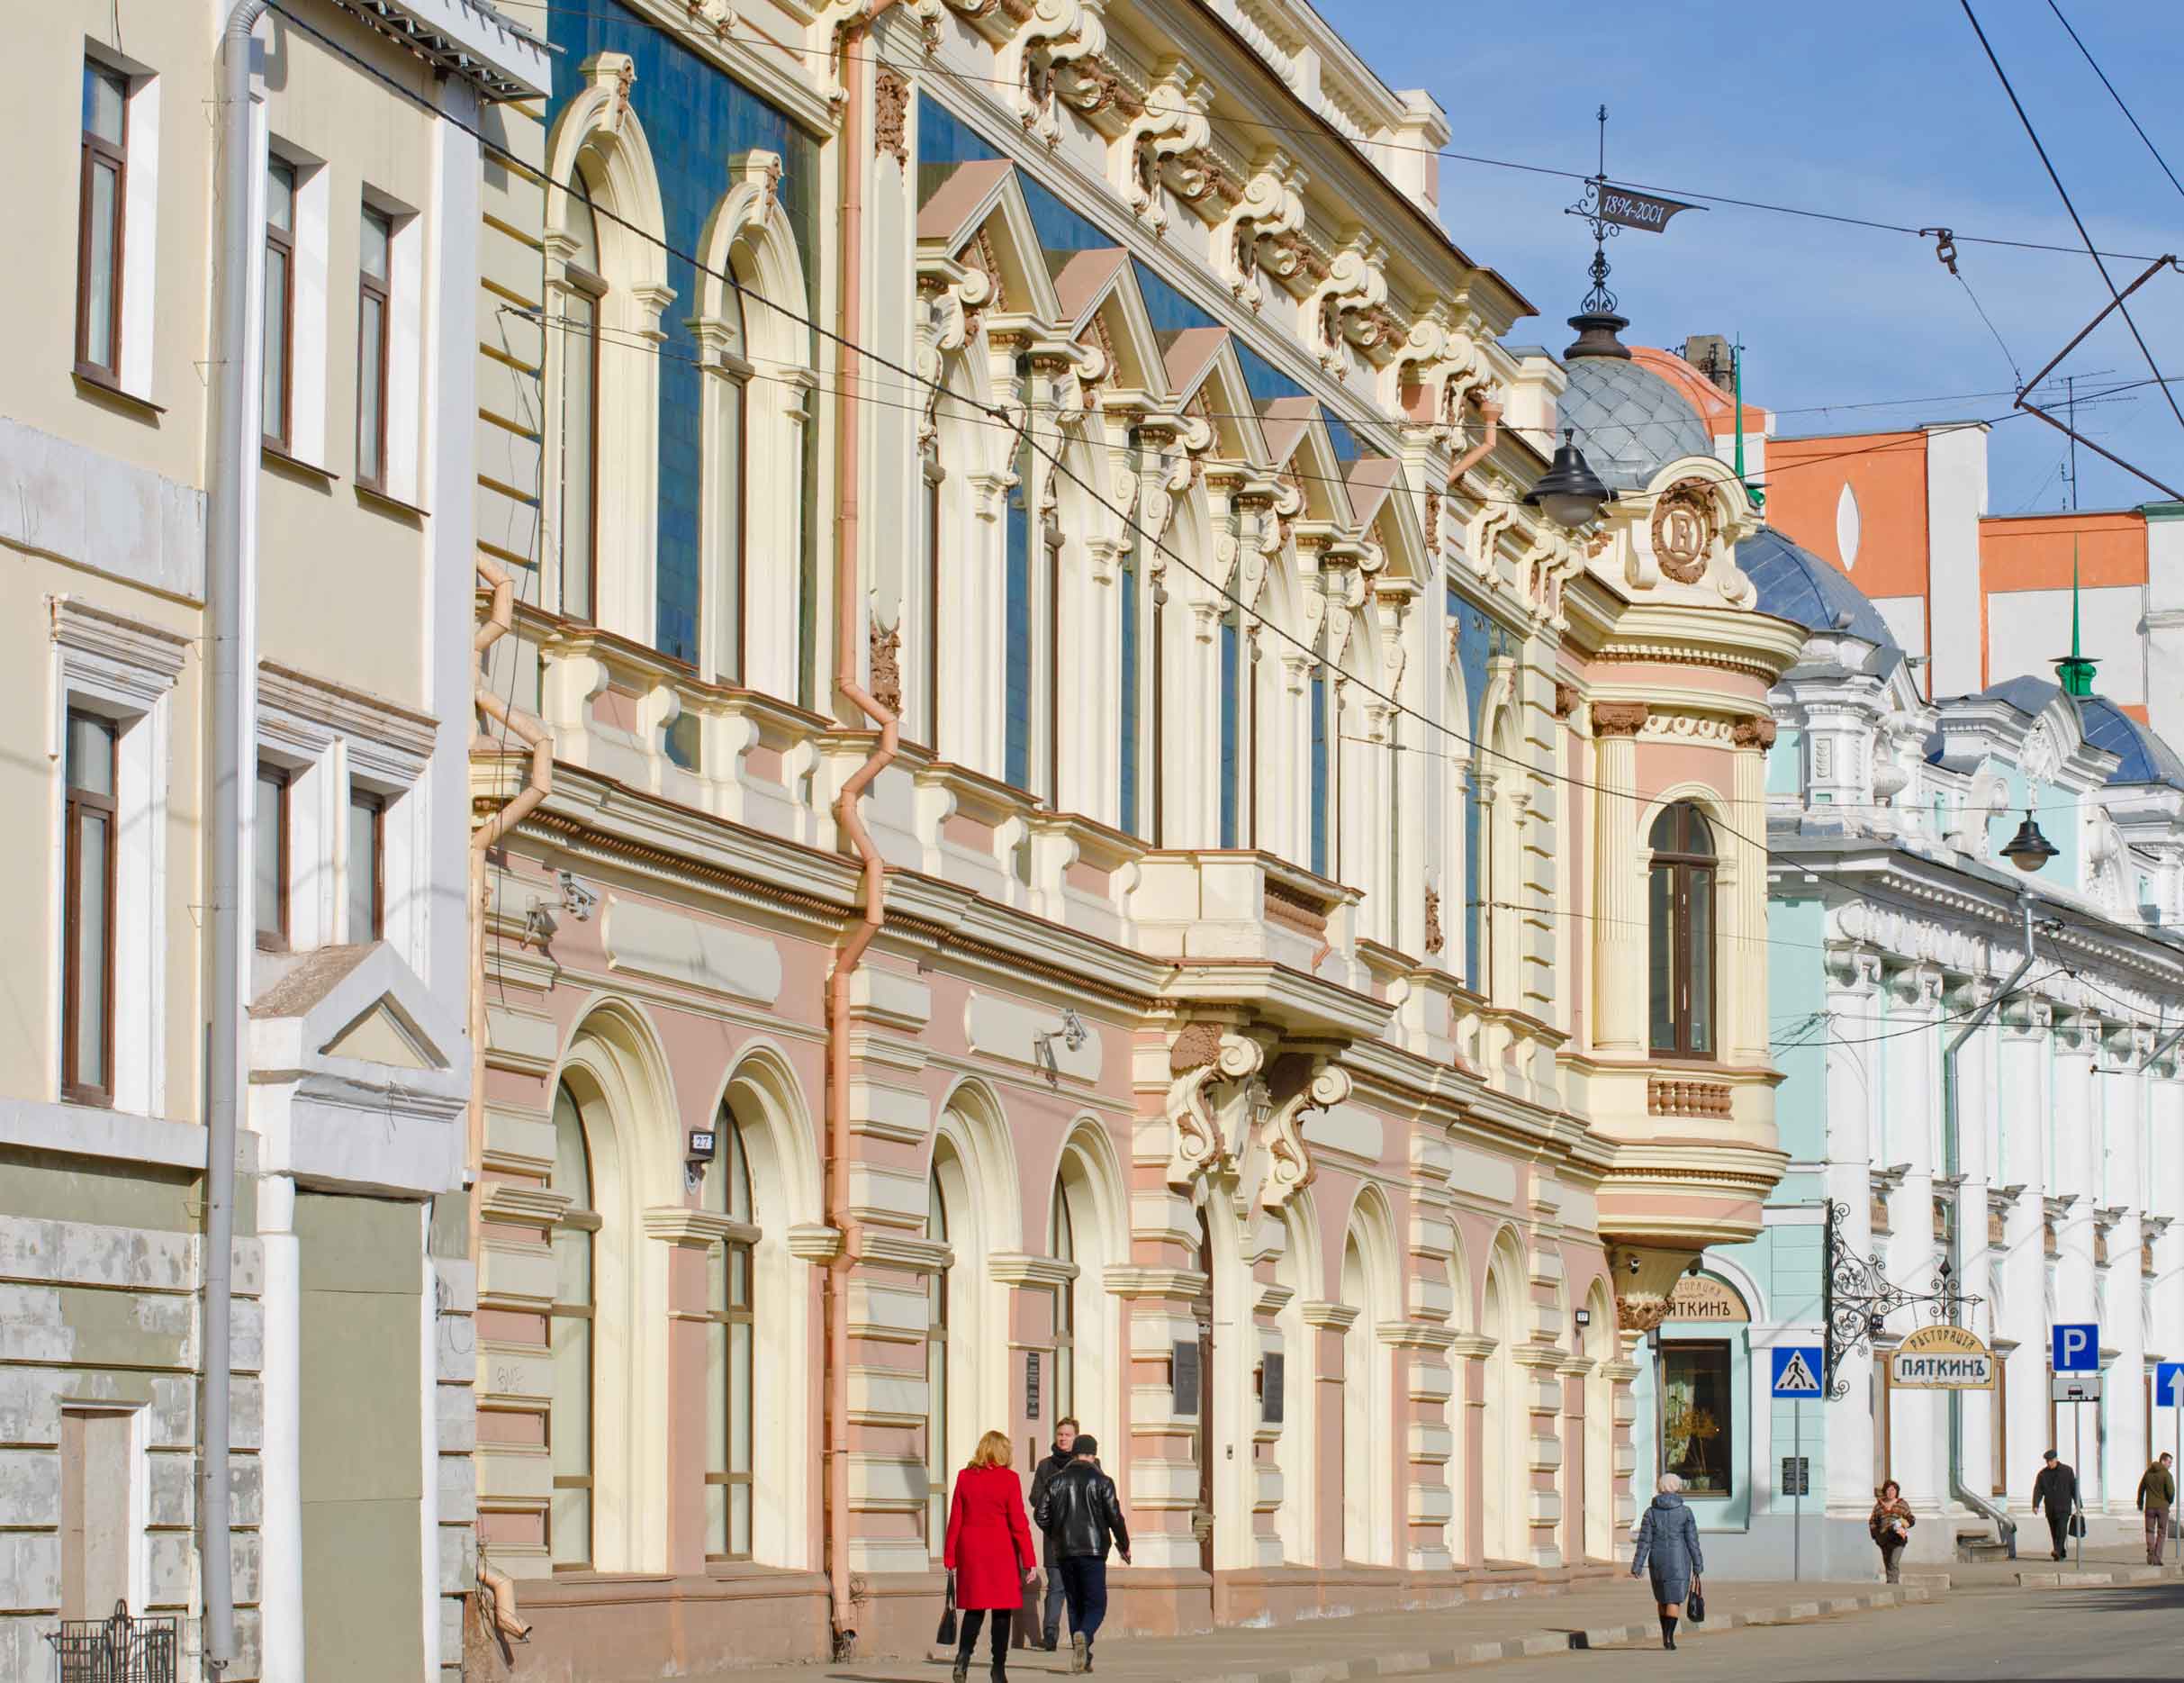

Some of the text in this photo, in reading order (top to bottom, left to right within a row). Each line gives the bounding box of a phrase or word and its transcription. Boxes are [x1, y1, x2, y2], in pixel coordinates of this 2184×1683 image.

[1604, 195, 1665, 223] 1894-2001
[697, 1136, 709, 1147] 27
[2063, 1328, 2087, 1367] P
[1901, 1359, 1986, 1377] ПЯТКИНЪ
